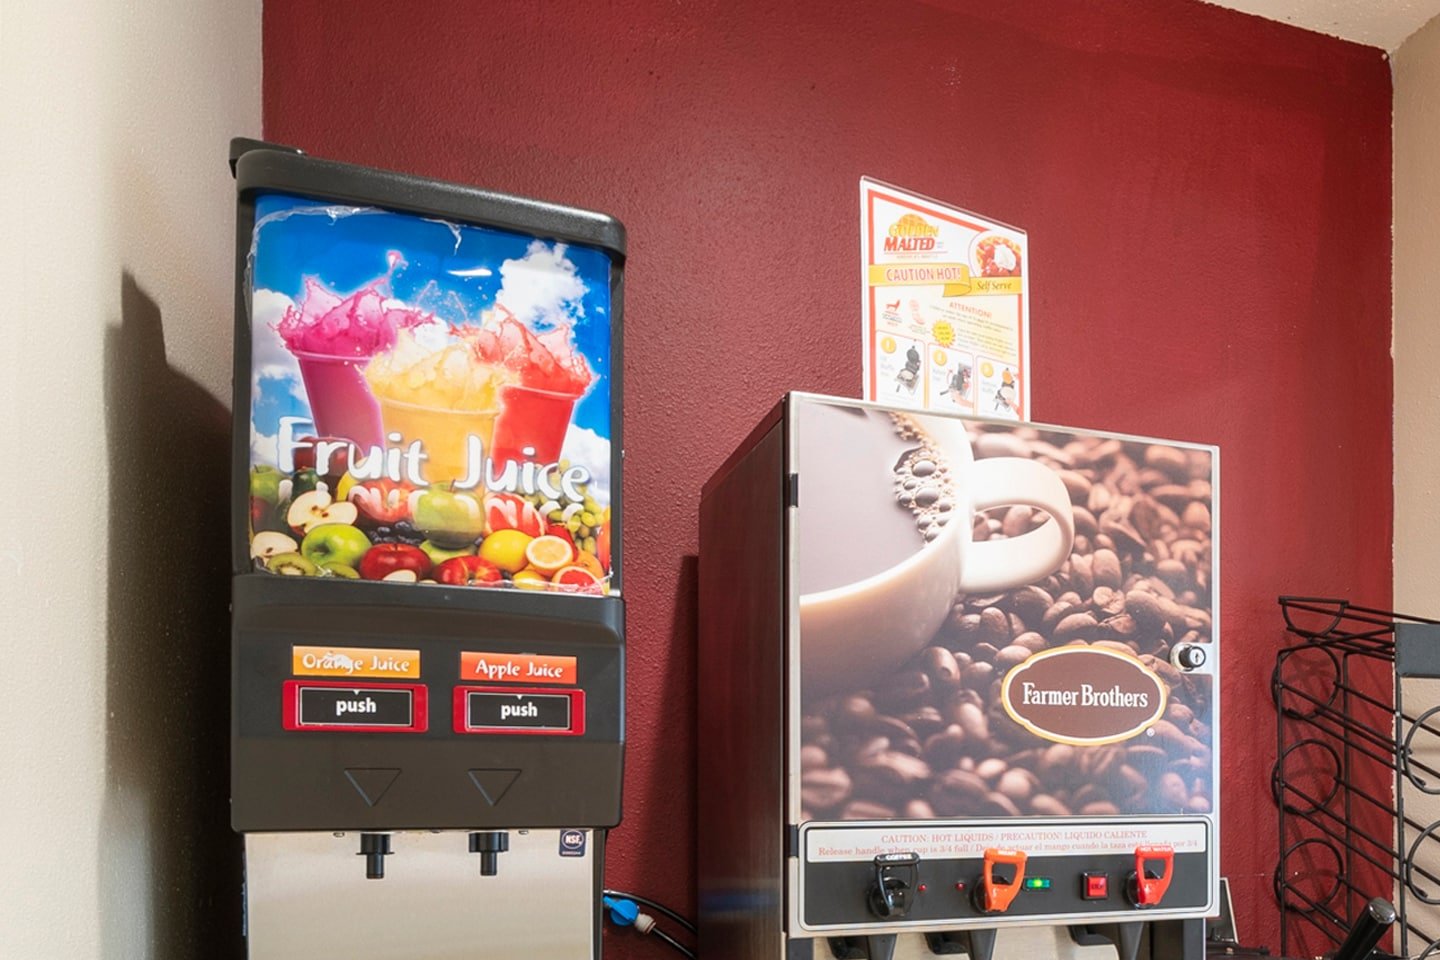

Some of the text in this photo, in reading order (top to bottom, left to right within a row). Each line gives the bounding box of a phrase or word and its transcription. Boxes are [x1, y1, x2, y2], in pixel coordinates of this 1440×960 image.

[884, 237, 935, 251] MALTED
[886, 267, 961, 282] CAUTION HOT!
[976, 281, 1012, 293] Self Serve
[277, 416, 592, 502] Fruit Juice
[302, 652, 410, 675] Orange Juice
[475, 659, 563, 680] Apple Juice
[1022, 682, 1148, 708] Farmer Brothers
[336, 698, 377, 716] push
[501, 701, 538, 719] push
[565, 834, 581, 845] NSF
[931, 834, 952, 843] HOT
[954, 832, 993, 843] LIQUIDS
[1064, 831, 1103, 841] LIQUIDO
[1104, 830, 1148, 839] CALIENTE
[818, 847, 853, 856] Release
[856, 845, 884, 855] handle
[887, 846, 910, 854] when
[912, 847, 928, 855] cup
[939, 844, 952, 853] 3/4
[954, 844, 968, 853] full
[1044, 843, 1070, 851] mango
[1071, 842, 1099, 850] cuando
[1101, 841, 1108, 849] la
[1110, 841, 1126, 849] taza
[1173, 840, 1185, 848] por
